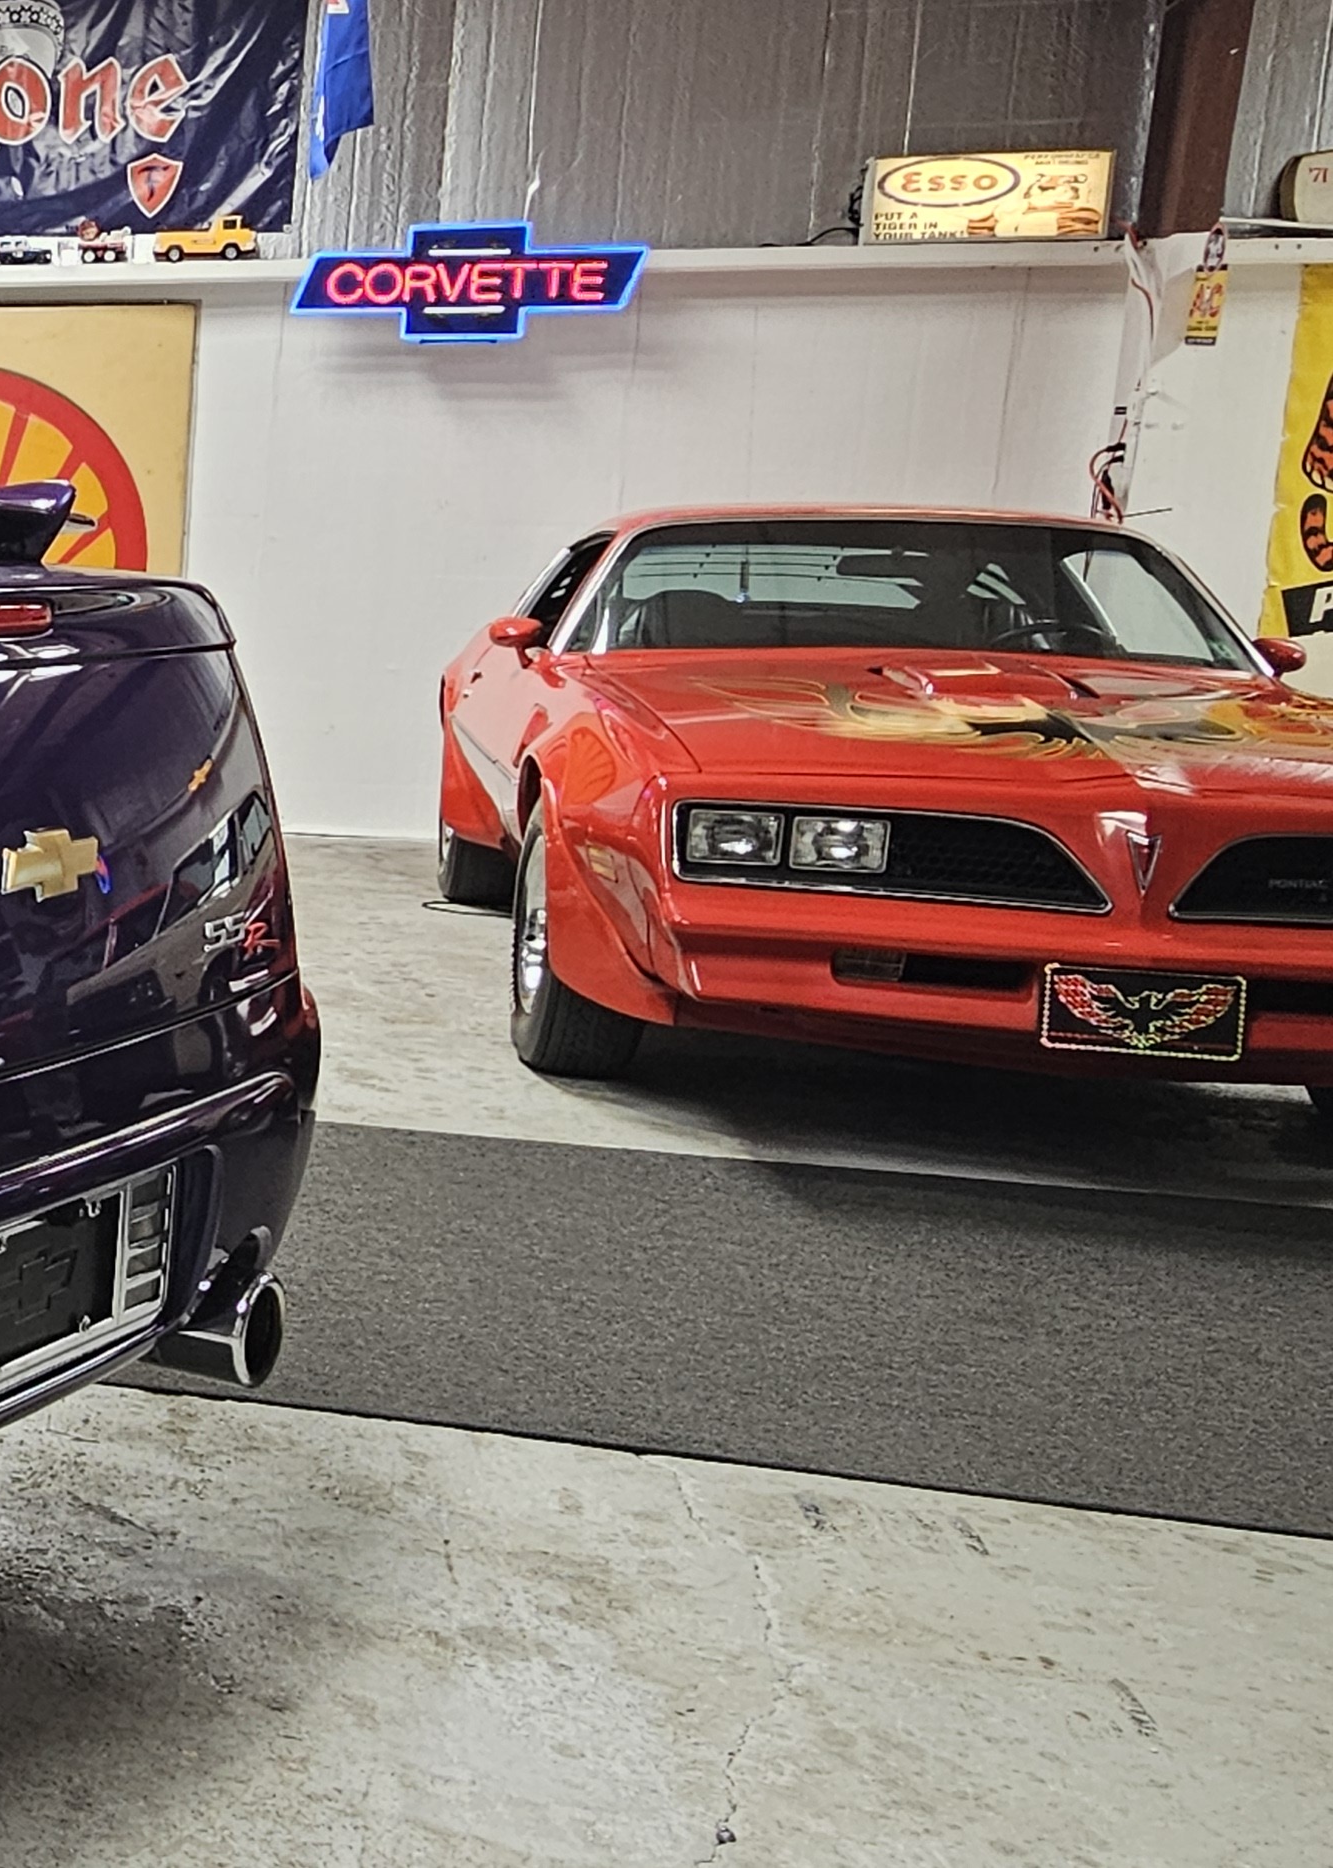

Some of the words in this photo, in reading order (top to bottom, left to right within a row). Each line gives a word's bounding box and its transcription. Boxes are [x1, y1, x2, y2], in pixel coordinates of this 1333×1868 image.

[874, 212, 903, 221] PUT
[910, 212, 919, 220] A
[874, 222, 918, 231] TIGER
[924, 222, 938, 230] IN
[874, 232, 913, 241] YOUR
[326, 260, 609, 305] CORVETTE
